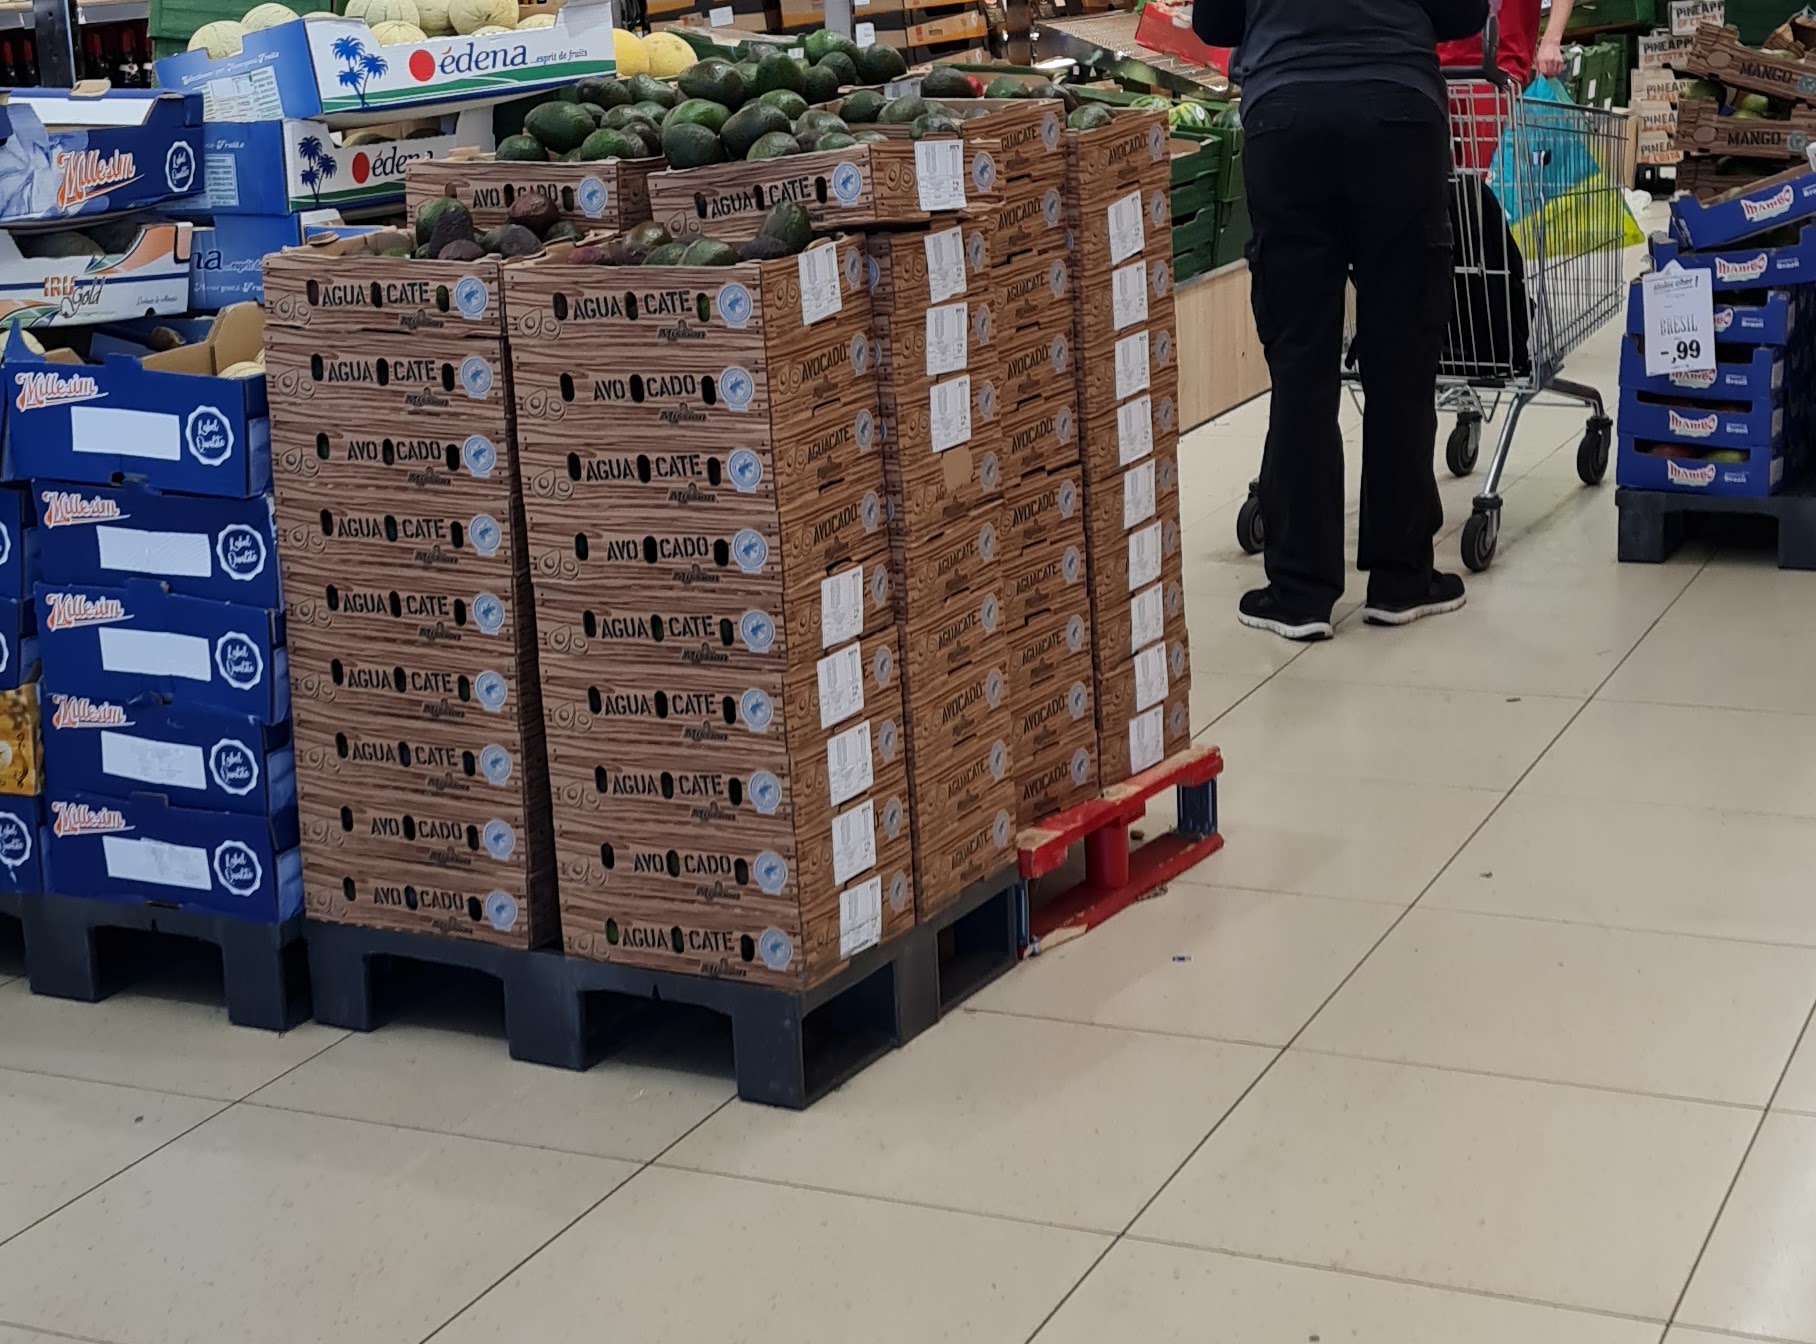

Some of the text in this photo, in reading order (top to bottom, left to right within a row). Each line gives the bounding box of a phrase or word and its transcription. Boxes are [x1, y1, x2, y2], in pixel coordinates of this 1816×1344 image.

[438, 42, 528, 75] édena
[1740, 63, 1793, 83] MANGO
[1001, 127, 1037, 152] GUACATE
[1108, 132, 1147, 166] AVOCADO
[1727, 132, 1781, 145] MANGO
[472, 187, 500, 208] AVO
[711, 177, 812, 219] AGUA CATE
[999, 197, 1042, 230] AVOCADO
[322, 282, 431, 307] AGUA CATE
[1006, 270, 1045, 304] AGUACATE
[573, 290, 693, 321] AGUA CATE
[327, 360, 437, 383] AGUA CATE
[801, 342, 848, 384] AVOCADO
[1007, 344, 1048, 380] AVOCADO
[593, 374, 696, 401] AVO CADO
[808, 424, 850, 464] AGUACATE
[1012, 416, 1053, 454] AVOCADO
[347, 440, 442, 461] AVO CADO
[586, 454, 703, 482] AGUA CATE
[1012, 489, 1056, 528] AVOCADO
[337, 517, 447, 539] AGUA CATE
[813, 503, 858, 546] AVOCADO
[607, 536, 709, 561] AVO CADO
[937, 542, 975, 577] AGUACATE
[1016, 560, 1057, 596] AGUACATE
[343, 592, 450, 616] AGUA CATE
[601, 615, 716, 639] AGUA CATE
[938, 612, 976, 650] AGUACATE
[1022, 629, 1061, 664] AGUACATE
[348, 669, 454, 692] AGUA CATE
[605, 693, 717, 715] AGUA CATE
[942, 682, 983, 725] AVOCADO
[1023, 695, 1065, 735] AVOCADO
[352, 741, 458, 767] AGUA CATE
[613, 774, 724, 796] AGUA CATE
[948, 758, 984, 799] AGUACATE
[1023, 761, 1068, 800] AVOCADO
[371, 817, 463, 840] AVO CADO
[634, 853, 732, 875] AVO CADO
[951, 830, 989, 870] AGUACATE
[373, 886, 464, 911] AVO CADO
[622, 928, 735, 952] AGUA CATE
